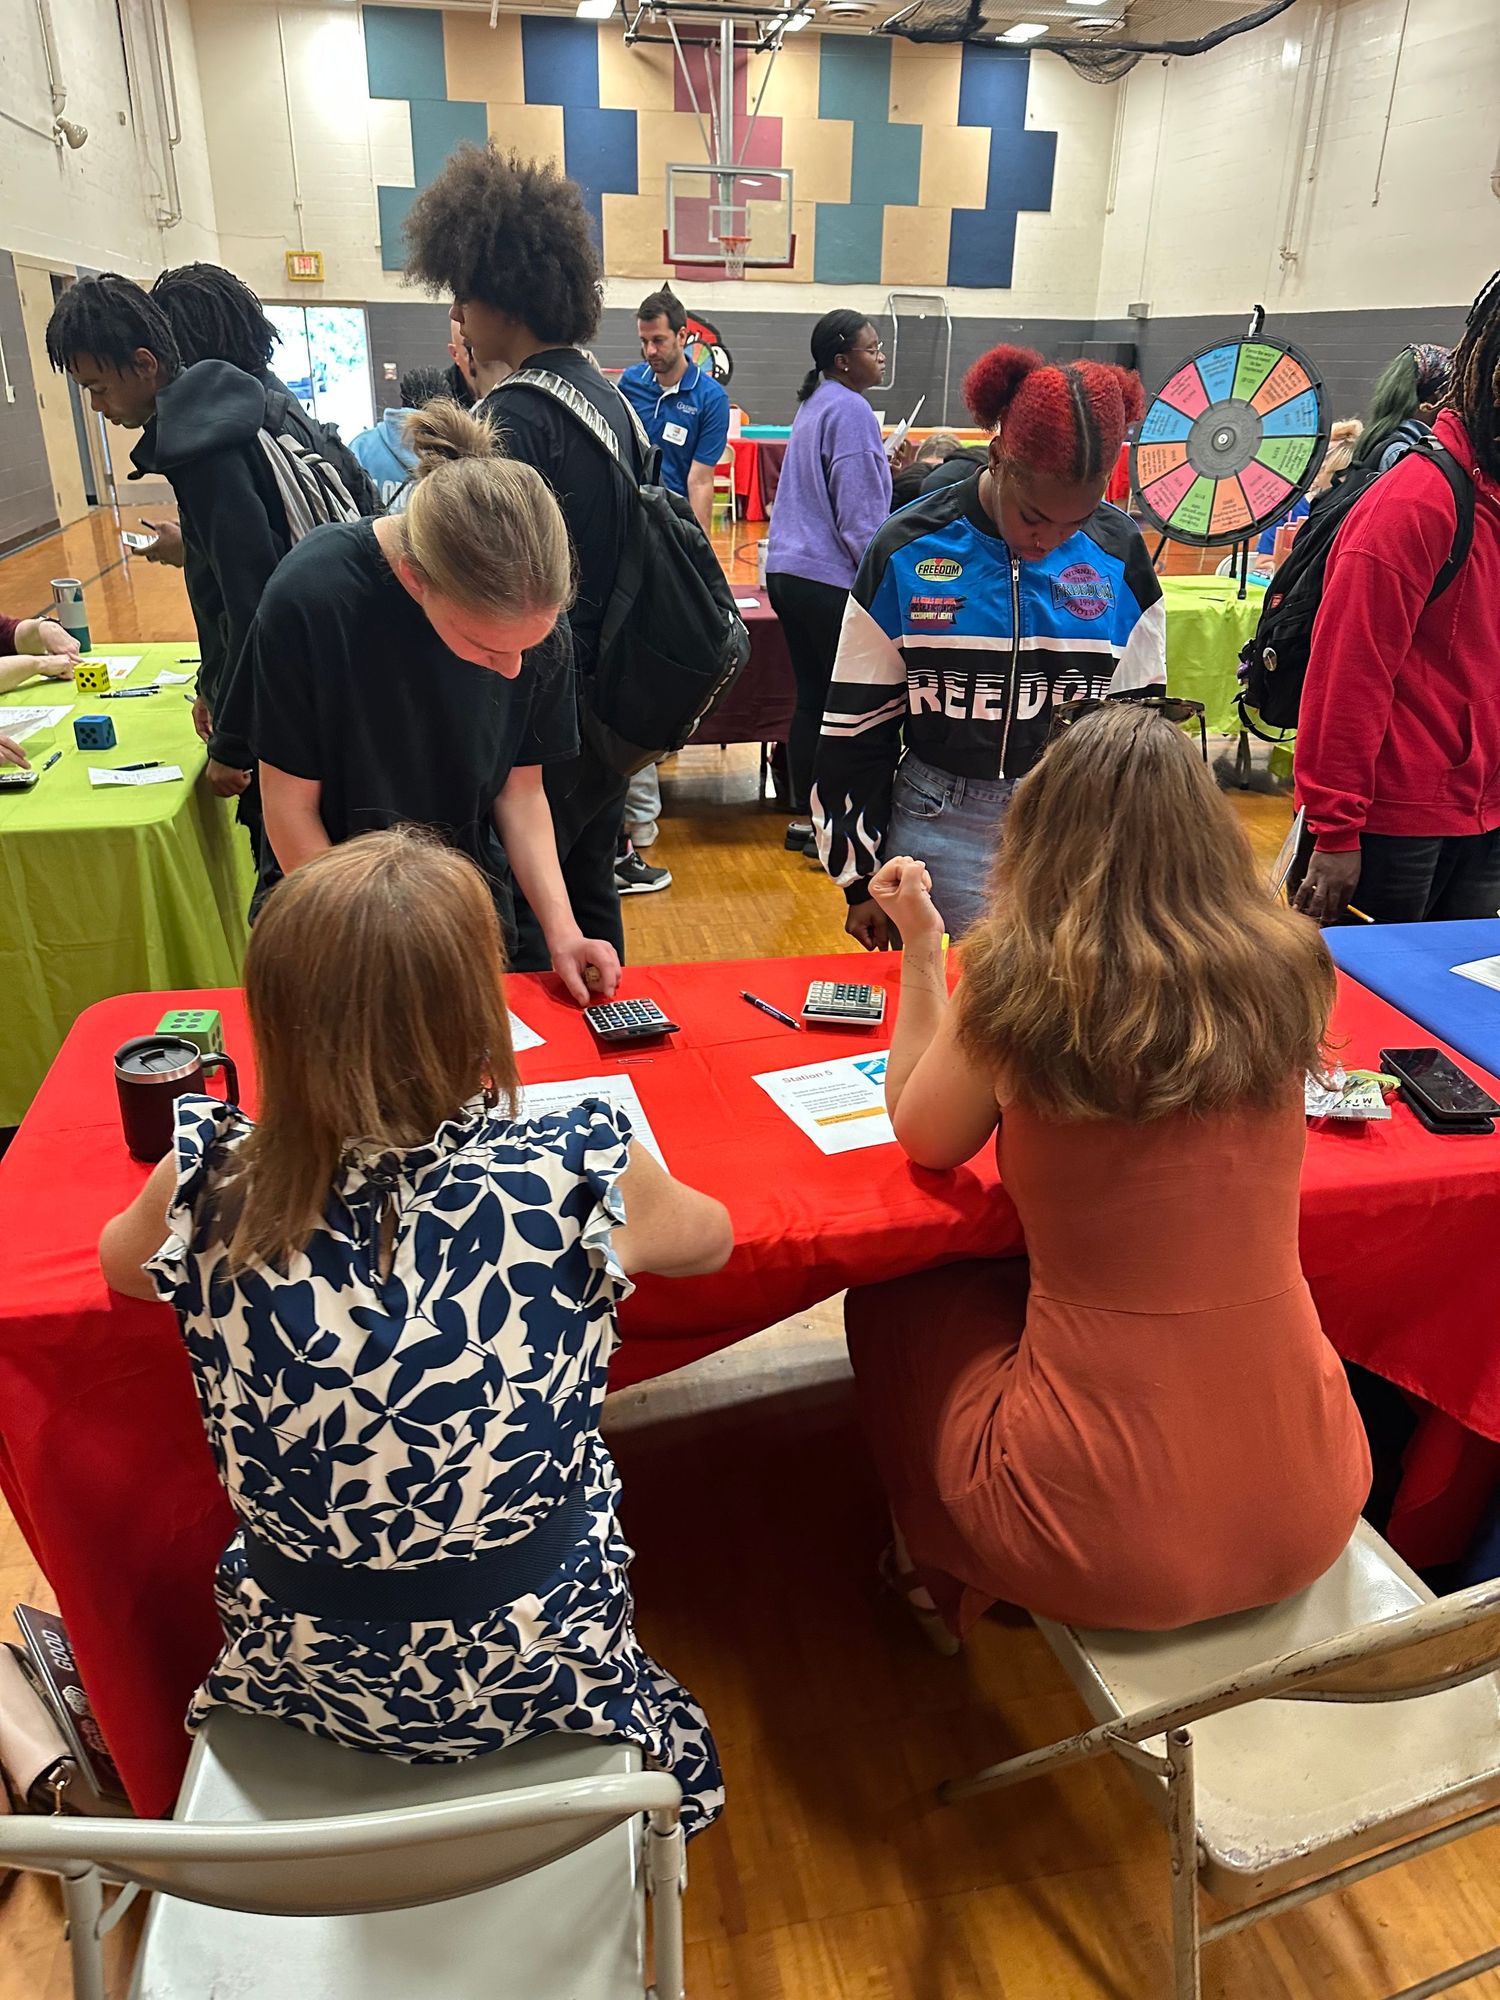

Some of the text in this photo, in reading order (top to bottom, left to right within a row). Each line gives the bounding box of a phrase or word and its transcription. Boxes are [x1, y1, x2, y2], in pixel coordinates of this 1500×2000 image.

[918, 564, 960, 575] FREEDOM
[1053, 583, 1114, 602] FREEDOM
[782, 1072, 824, 1084] Station
[41, 1629, 75, 1672] GOOD
